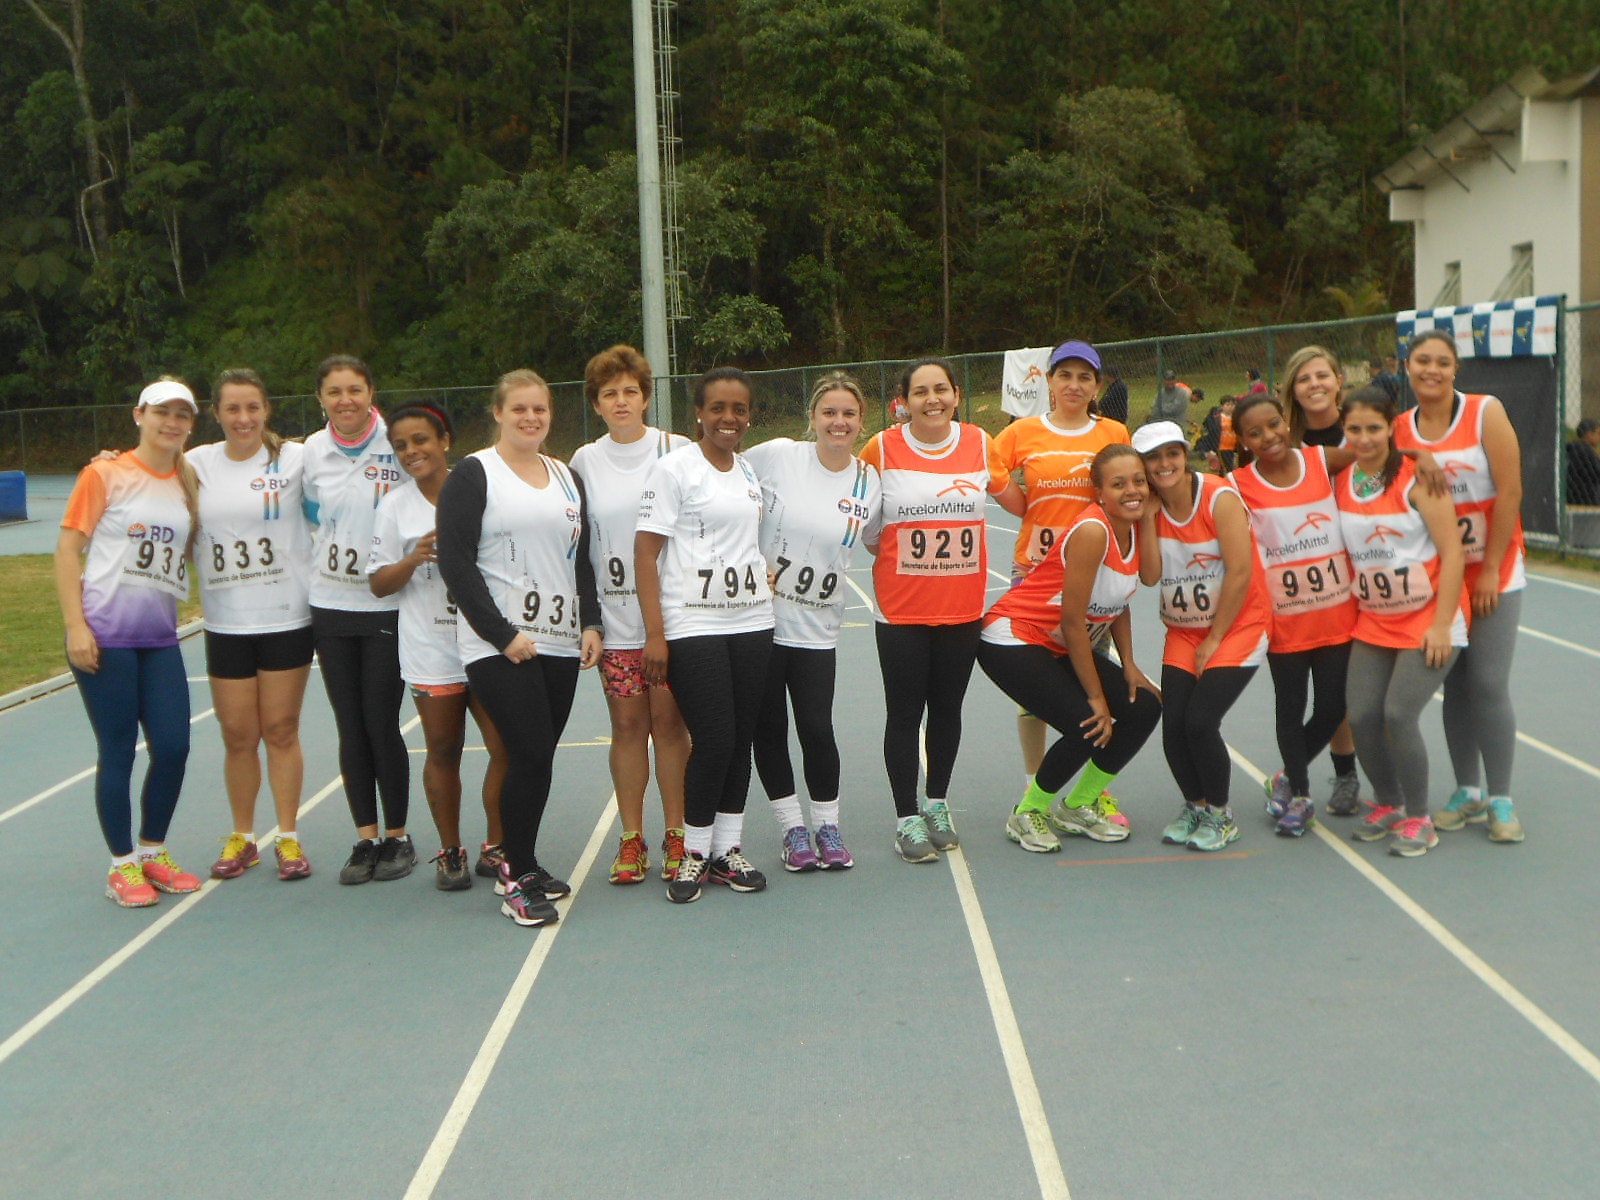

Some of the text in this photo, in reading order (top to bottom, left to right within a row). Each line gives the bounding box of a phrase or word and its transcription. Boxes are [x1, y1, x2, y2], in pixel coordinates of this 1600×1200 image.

[381, 468, 400, 481] BD
[898, 502, 975, 516] ArcelorMittal
[150, 525, 174, 543] BD
[911, 528, 973, 559] 929
[1266, 534, 1329, 558] ArcelorMittal
[136, 540, 186, 581] 938
[212, 537, 274, 573] 833
[328, 543, 359, 576] 82
[902, 561, 929, 569] Secretaria
[931, 560, 938, 569] de
[940, 561, 960, 571] Esporte
[698, 565, 757, 599] 794
[774, 556, 838, 600] 799
[1282, 558, 1340, 597] 991
[1359, 566, 1409, 600] 997
[1161, 583, 1210, 613] 46
